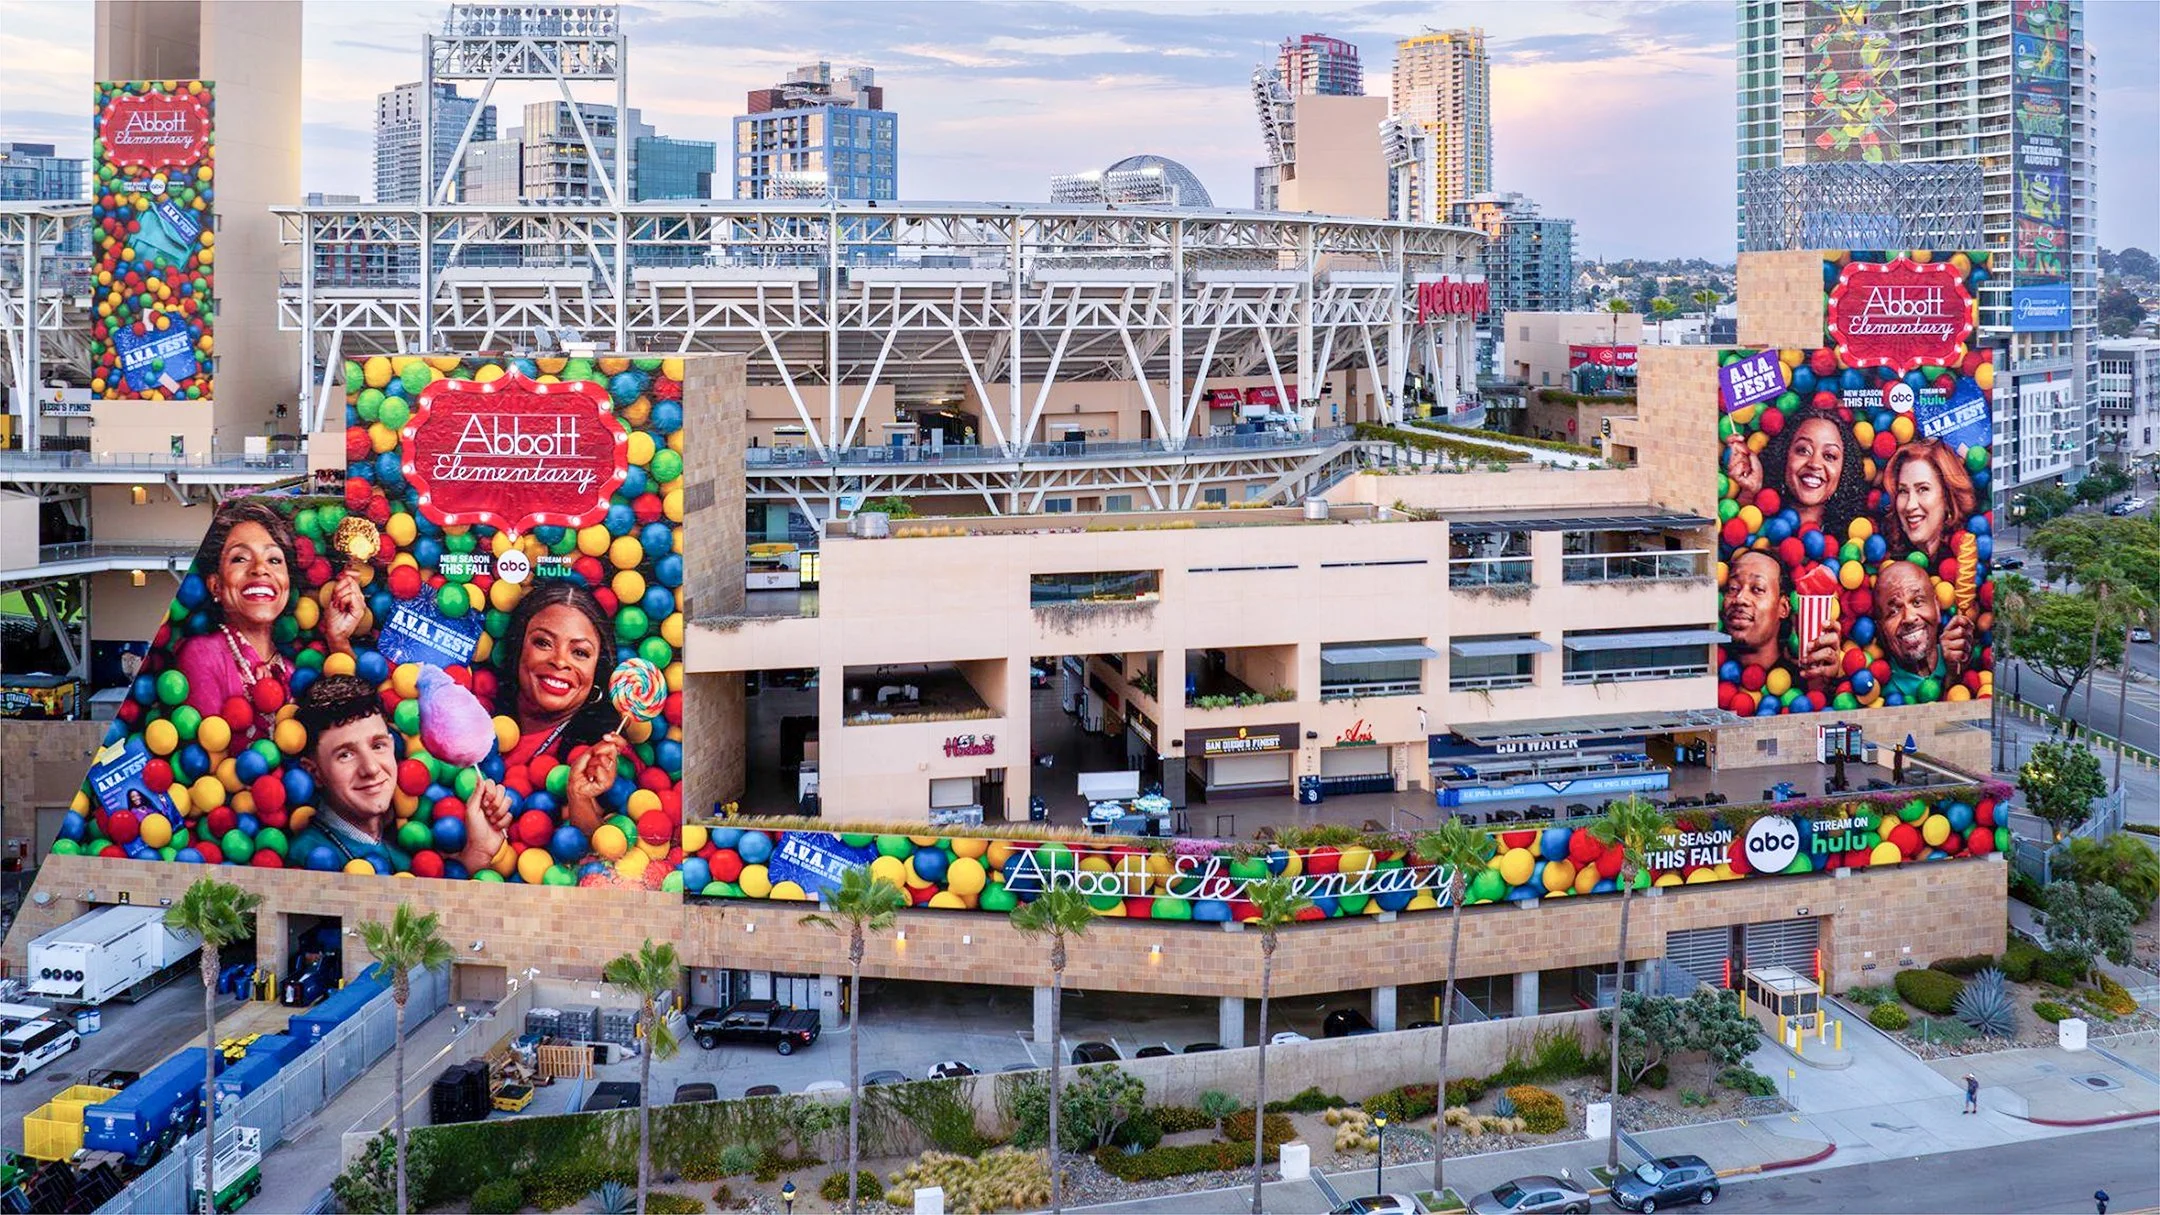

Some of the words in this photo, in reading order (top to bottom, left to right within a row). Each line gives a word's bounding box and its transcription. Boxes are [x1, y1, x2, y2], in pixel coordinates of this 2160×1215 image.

[126, 111, 186, 131] Abbott
[115, 131, 194, 149] Elementary
[2021, 145, 2062, 157] STREAMING
[2024, 155, 2053, 166] AUGUST
[1863, 286, 1944, 315] Abbott
[1848, 316, 1954, 341] Elementary
[1730, 357, 1773, 384] A.V.A.
[1733, 371, 1776, 400] FEST
[1843, 389, 1858, 397] NEW
[1859, 389, 1884, 397] SEASON
[1843, 397, 1863, 407] THIS
[1864, 397, 1884, 407] FALL
[1891, 392, 1913, 403] abc
[1920, 395, 1946, 405] hulu
[1924, 415, 1955, 437] A.V.A.
[1955, 402, 1985, 424] FEST
[454, 414, 581, 456] Abbott
[433, 455, 597, 494] Elementary
[440, 555, 458, 564] NEW
[458, 555, 490, 564] SEASON
[500, 560, 527, 572] abc
[440, 564, 465, 575] THIS
[466, 564, 490, 575] FALL
[537, 563, 571, 577] hulu
[392, 609, 435, 639] A.V.A.
[432, 629, 473, 657] FEST
[1205, 741, 1220, 750] SAN
[1252, 738, 1280, 748] FINEST
[98, 773, 126, 792] A.V.A.
[1812, 818, 1850, 832] STREAM
[1853, 817, 1868, 828] ON
[1679, 830, 1732, 848] SEASON
[1750, 832, 1795, 853] abc
[1812, 832, 1868, 854] hulu
[782, 839, 829, 869] A.V.A.
[1645, 850, 1686, 870] THIS
[1691, 846, 1732, 866] FALL
[1004, 850, 1151, 896] Abbott
